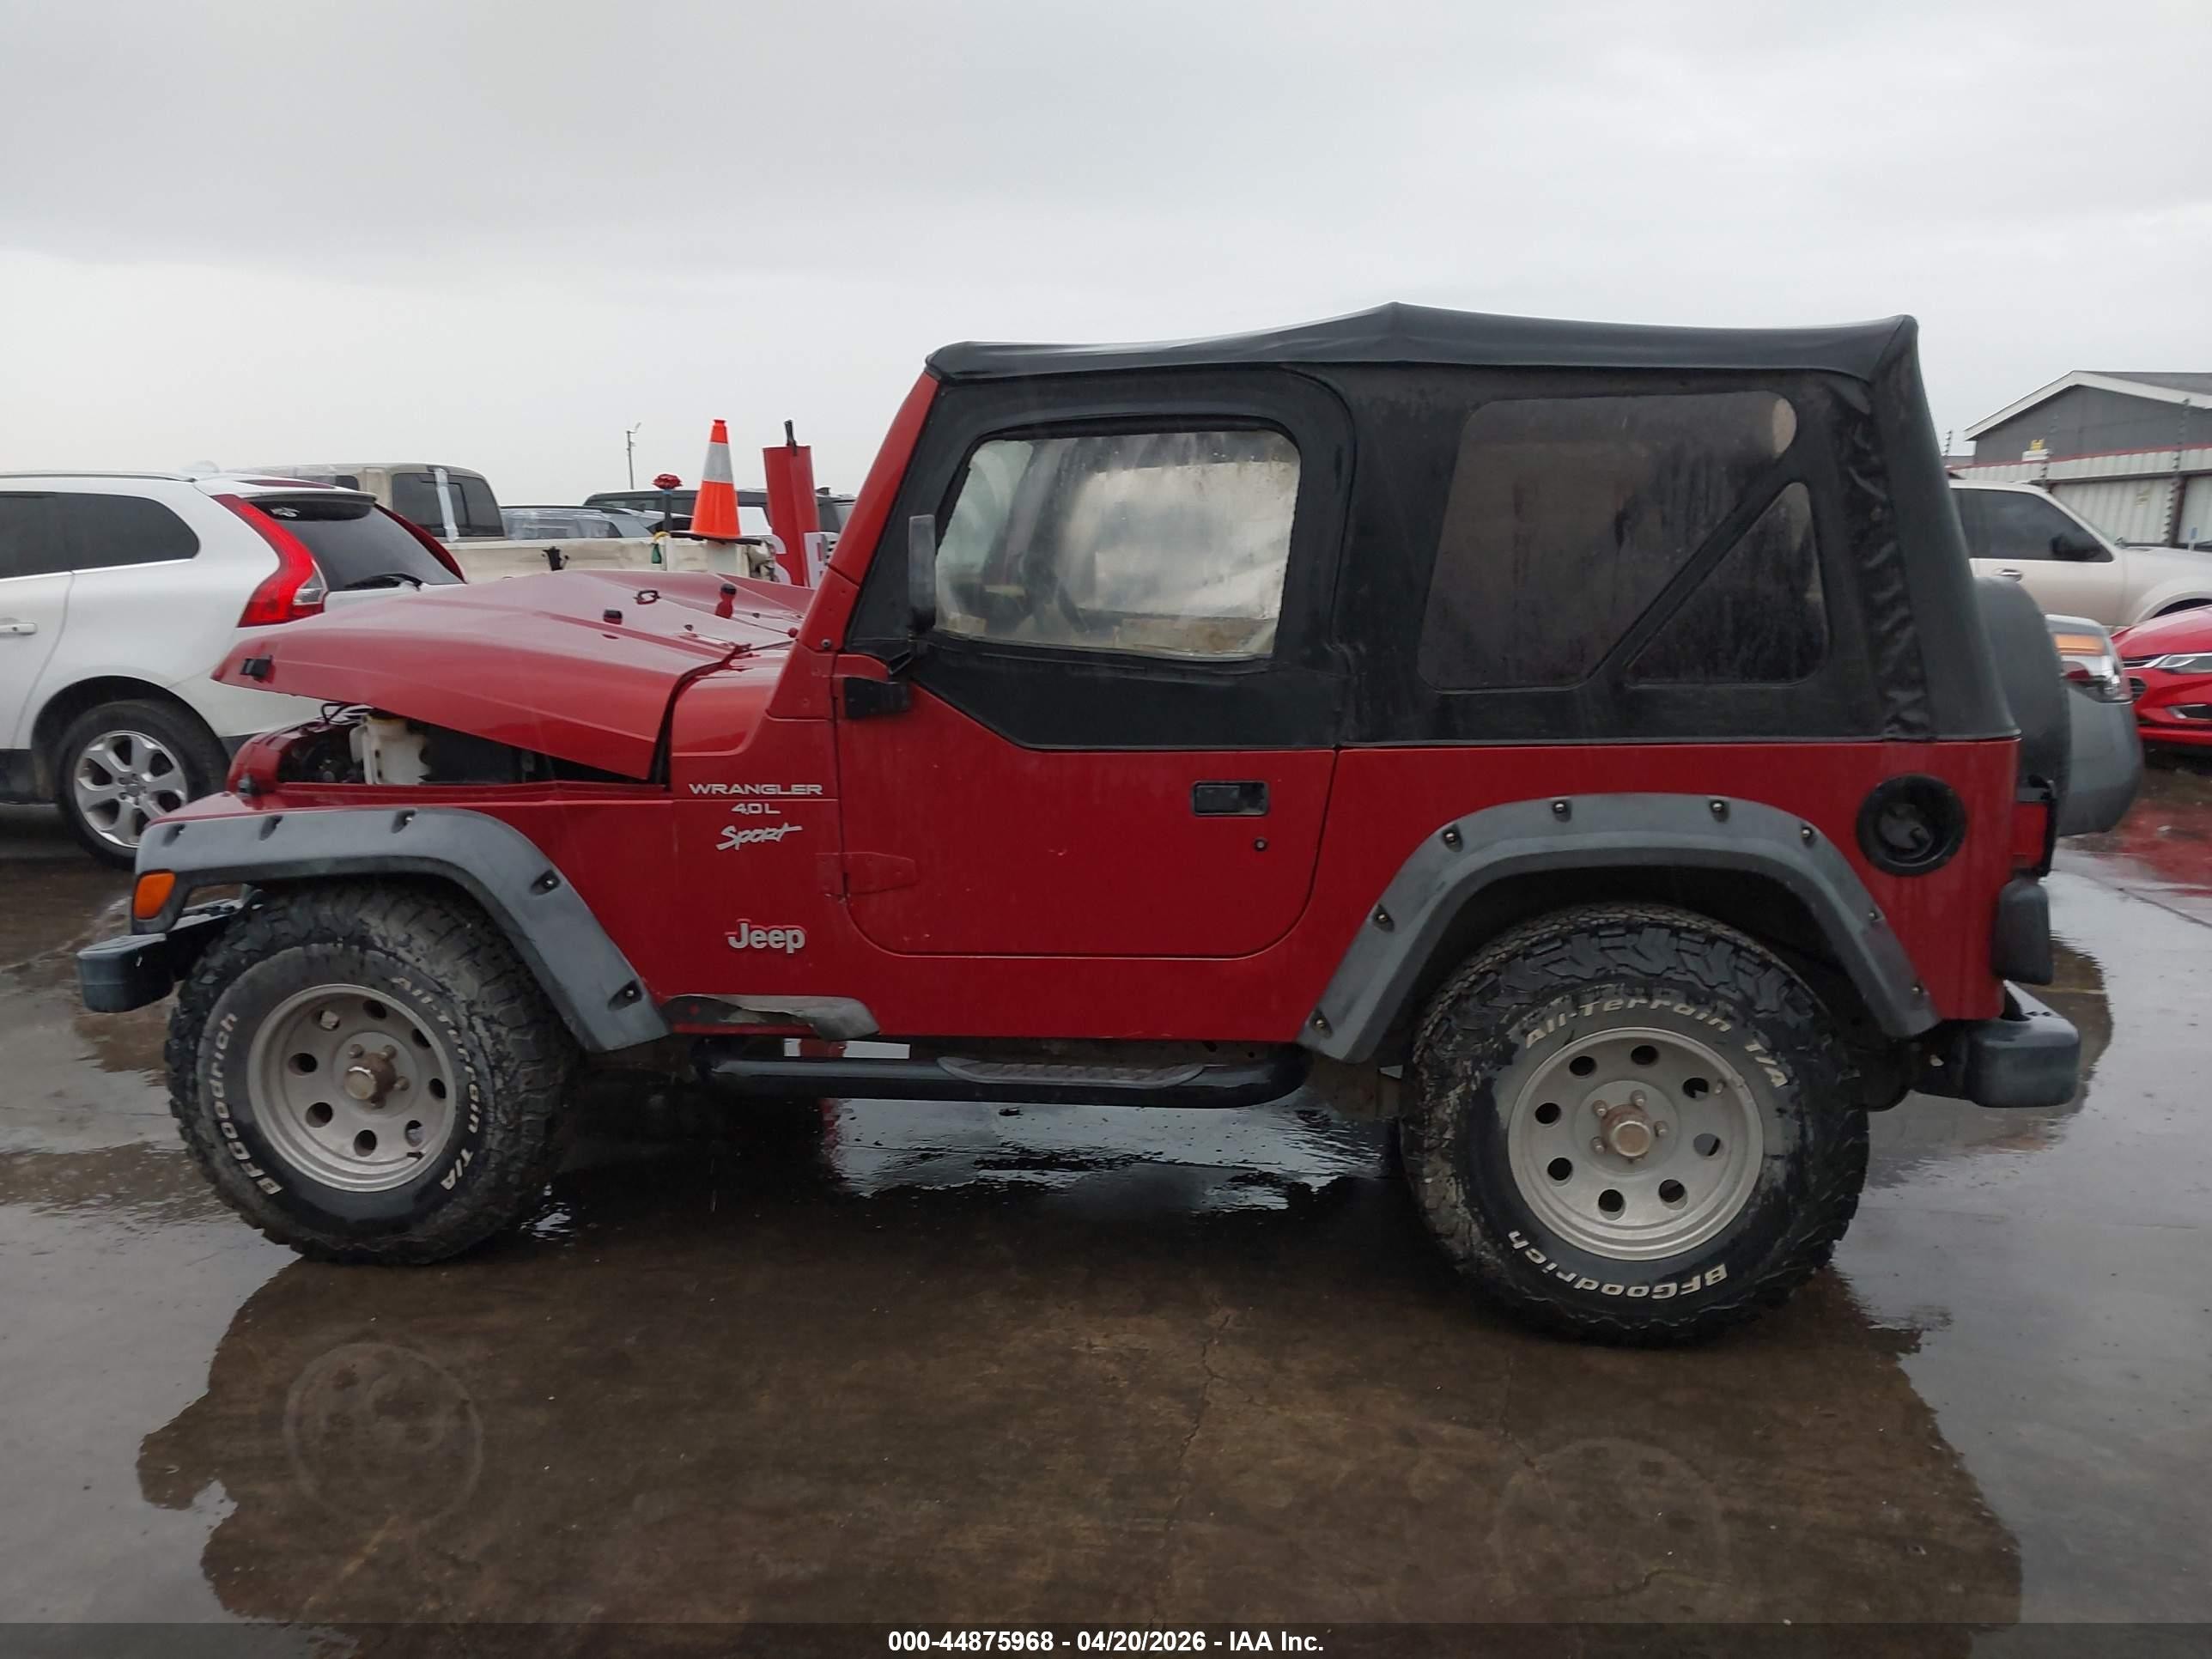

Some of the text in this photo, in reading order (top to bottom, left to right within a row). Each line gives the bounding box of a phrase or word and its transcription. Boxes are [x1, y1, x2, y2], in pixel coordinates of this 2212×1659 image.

[689, 782, 823, 795] WRANGLER
[715, 822, 804, 850] Sport
[728, 921, 806, 954] Jeep
[1525, 998, 1789, 1088] All-Terrain T/A
[209, 1012, 283, 1195] BFGoodrich
[440, 1148, 474, 1191] T/A
[1507, 1230, 1729, 1300] BFGoodrich
